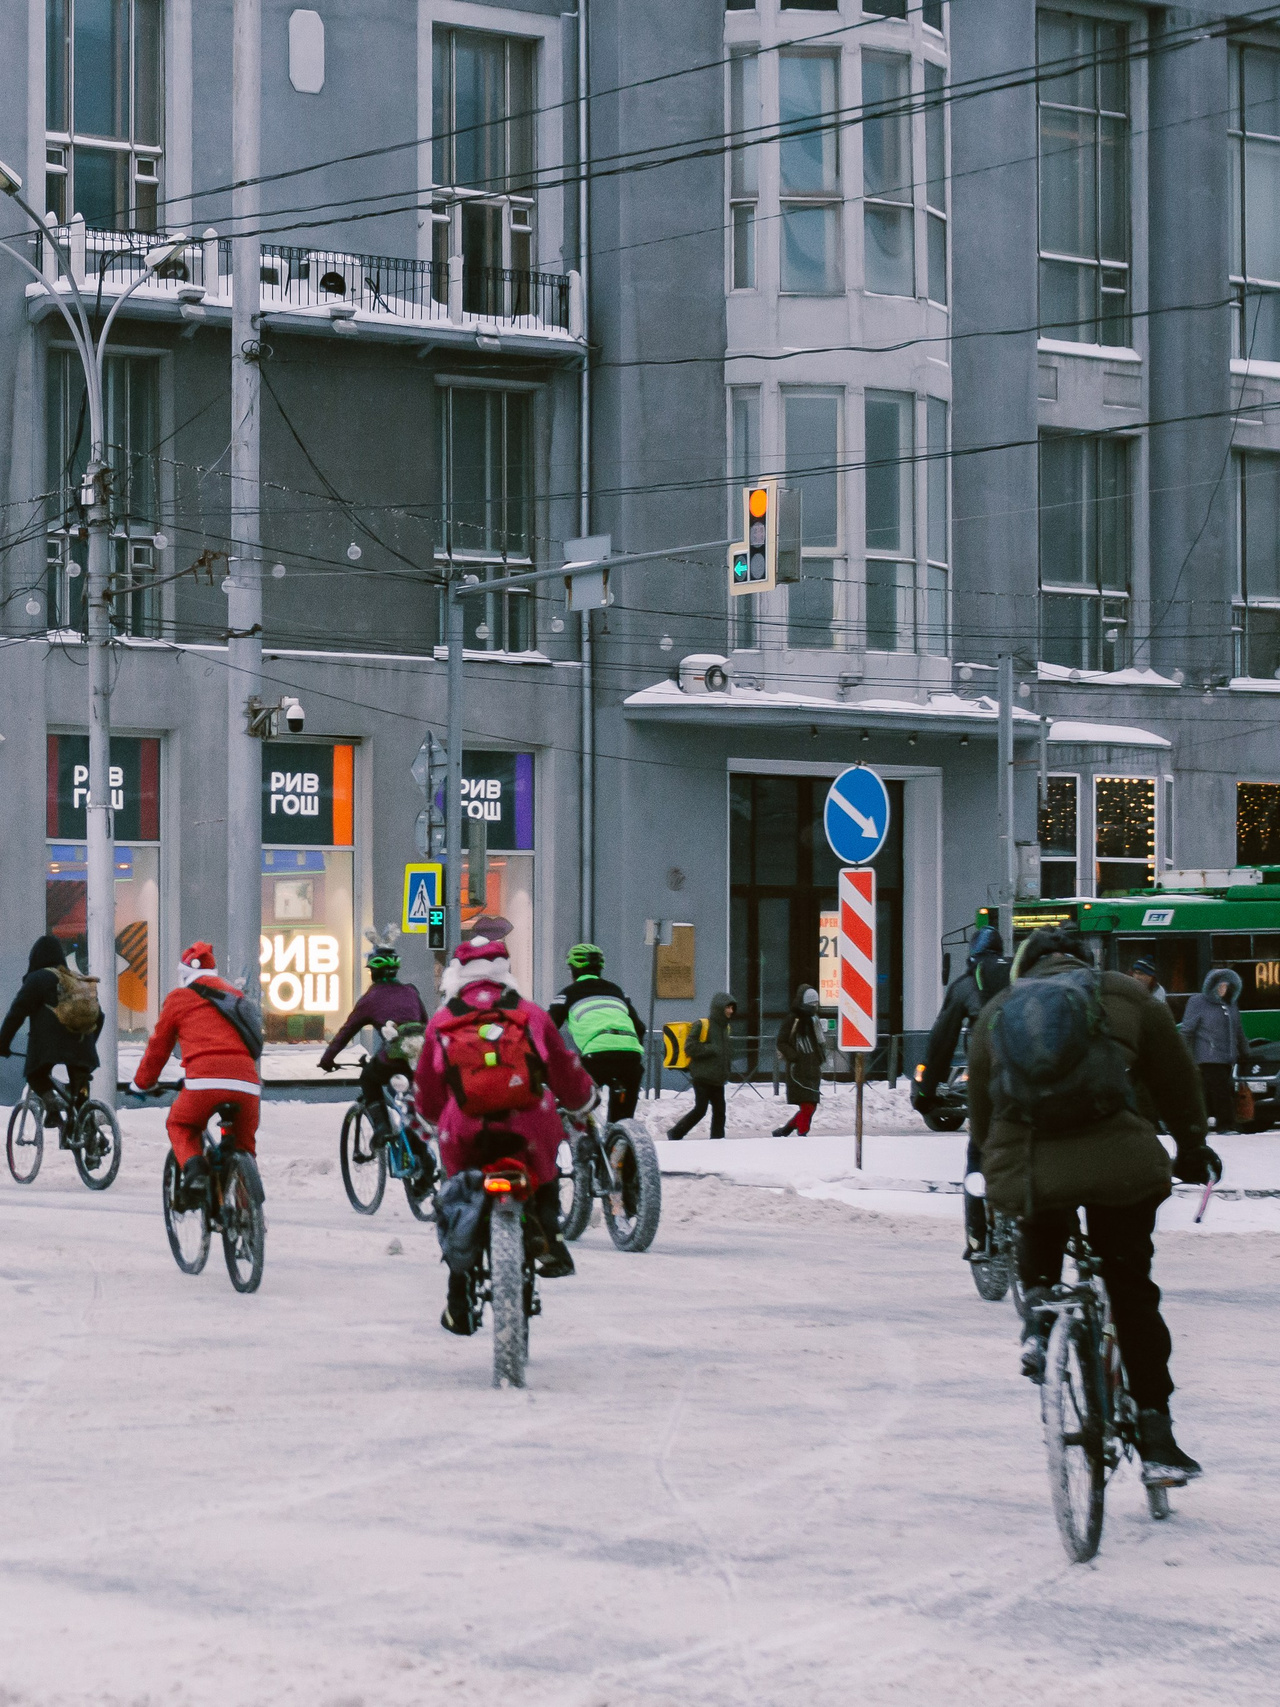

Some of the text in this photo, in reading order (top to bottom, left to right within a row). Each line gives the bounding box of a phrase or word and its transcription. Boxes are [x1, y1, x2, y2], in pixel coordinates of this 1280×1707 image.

[74, 765, 124, 787] РВ
[271, 771, 319, 793] РИВ
[74, 788, 124, 809] ГШ
[271, 794, 319, 816] ГОШ
